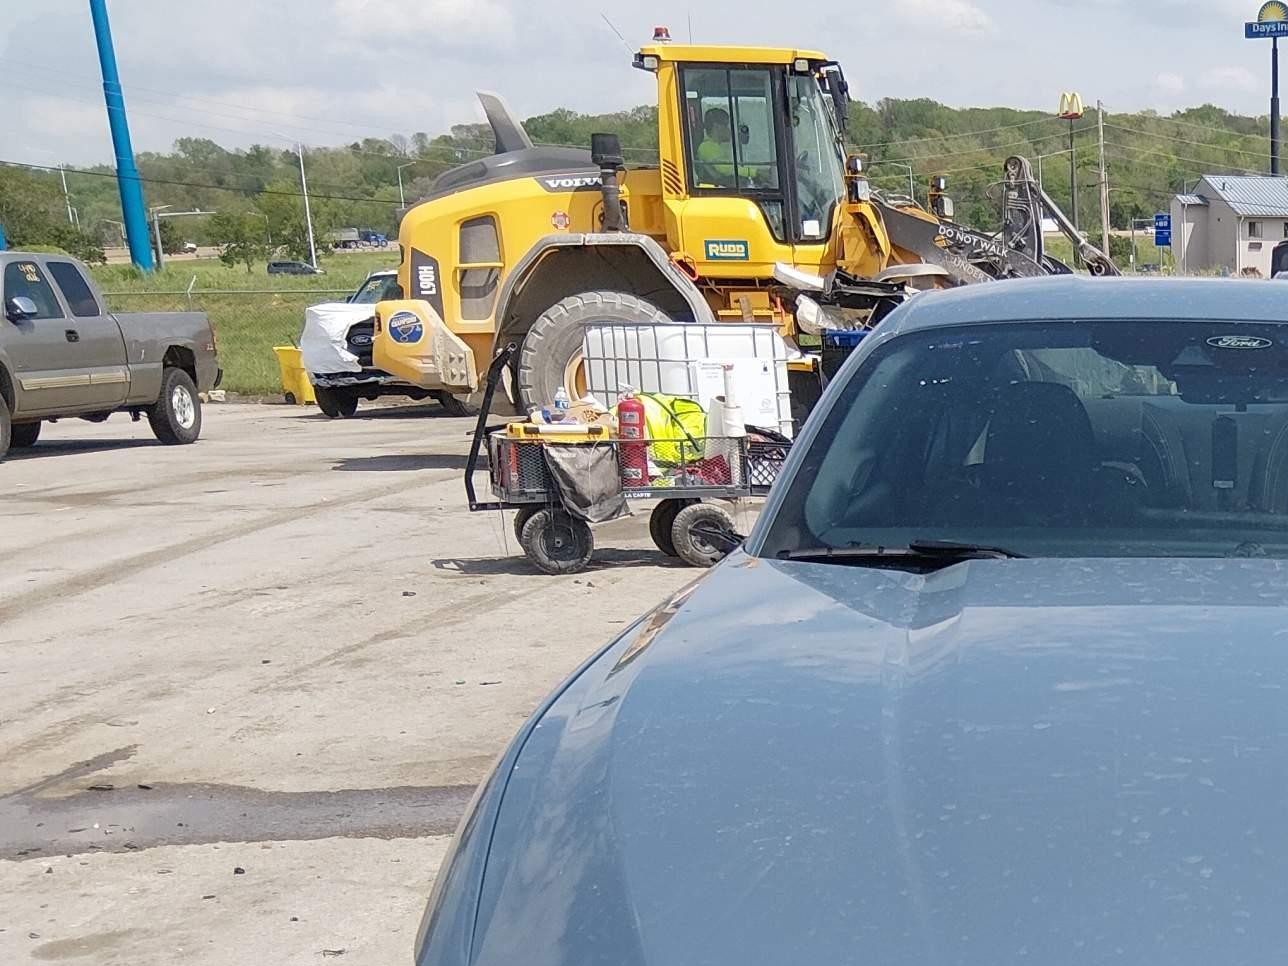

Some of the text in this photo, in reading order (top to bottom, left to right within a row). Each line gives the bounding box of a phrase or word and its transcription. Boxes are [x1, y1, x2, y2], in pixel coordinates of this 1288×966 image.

[1252, 23, 1276, 33] Days
[938, 225, 1008, 258] DO NOT WALK
[708, 244, 746, 257] RUDD
[418, 265, 437, 295] L90H
[1216, 336, 1261, 347] Ford
